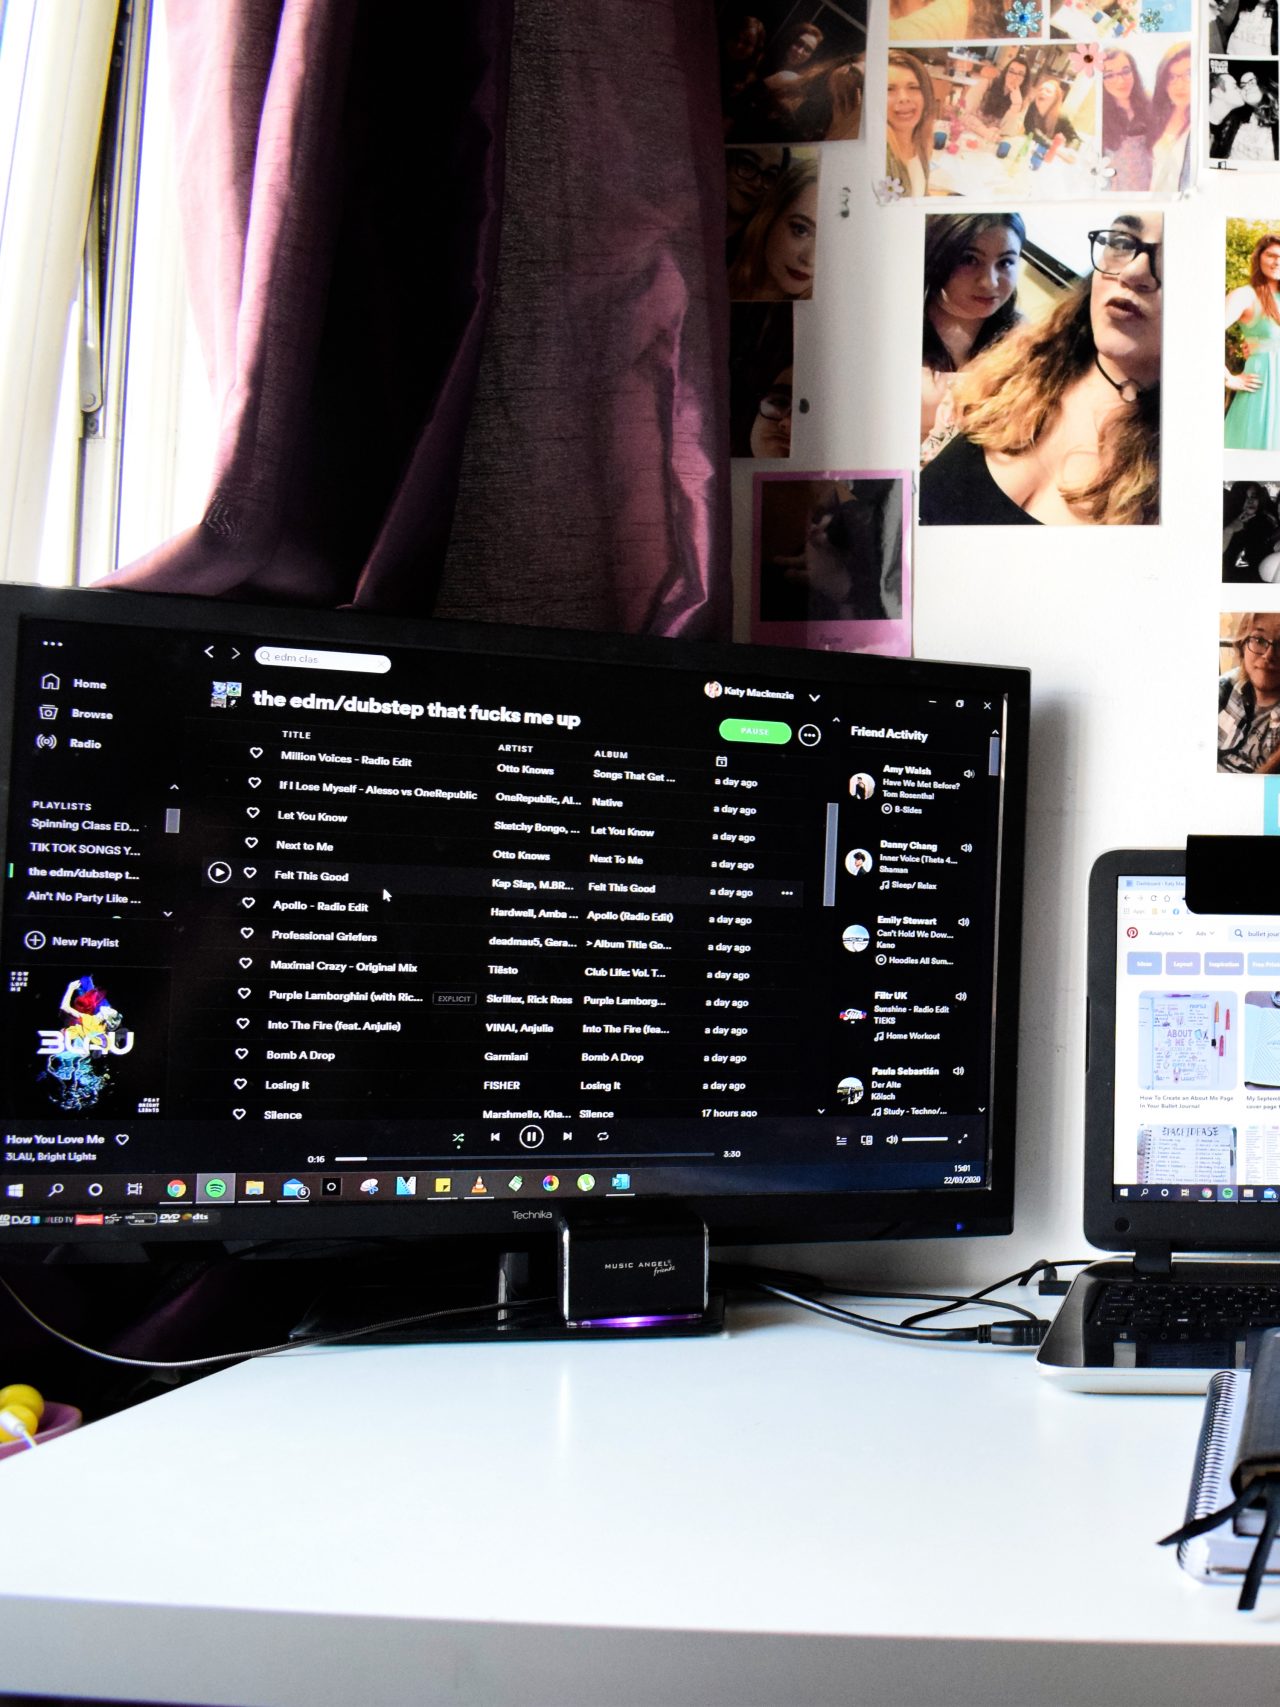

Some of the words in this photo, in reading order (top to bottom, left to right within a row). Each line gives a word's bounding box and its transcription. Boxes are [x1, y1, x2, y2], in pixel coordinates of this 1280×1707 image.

[274, 653, 297, 662] edm
[73, 678, 107, 689] Home
[724, 686, 746, 698] Katy
[746, 687, 794, 700] Mackenzie
[71, 708, 113, 720] Browse
[252, 689, 286, 707] the
[288, 692, 424, 719] edm/dubstep
[426, 701, 466, 719] that
[469, 704, 521, 723] fucks
[523, 711, 554, 725] me
[556, 714, 581, 730] up
[281, 730, 311, 739] TITLE
[740, 727, 769, 736] PAUSE
[850, 725, 885, 738] Friend
[885, 728, 928, 743] Activity
[69, 738, 102, 749] Radio
[497, 743, 533, 753] ARTIST
[593, 750, 628, 759] ALBUM
[496, 763, 520, 773] Otto
[521, 764, 554, 775] Knows
[882, 764, 904, 775] Amy
[904, 765, 931, 775] Walsh
[722, 776, 739, 788] day
[740, 779, 758, 789] ago
[882, 789, 898, 798] Tom
[898, 790, 934, 800] Rosenthal
[32, 800, 92, 811] PLAYLISTS
[591, 797, 623, 807] Native
[894, 805, 922, 814] B-Sides
[277, 810, 295, 820] Let
[295, 811, 316, 821] You
[317, 812, 348, 822] Know
[30, 817, 79, 831] Spinning
[81, 820, 111, 830] Class
[113, 821, 139, 832] ED...
[29, 842, 50, 852] TIK
[50, 842, 77, 853] TOK
[78, 844, 121, 855] SONGS
[122, 846, 140, 856] Y...
[879, 839, 908, 851] Danny
[908, 841, 937, 852] Chang
[274, 870, 294, 879] Felt
[296, 870, 318, 880] This
[319, 871, 349, 882] Good
[876, 915, 902, 926] Emily
[902, 916, 937, 925] Stewart
[271, 929, 334, 940] Professional
[335, 931, 377, 942] Griefers
[52, 936, 78, 946] New
[80, 937, 119, 949] Playlist
[268, 990, 303, 1001] Purple
[304, 990, 368, 1002] Lamborghini
[369, 991, 396, 1002] (with
[397, 992, 423, 1002] Ric...
[438, 995, 471, 1004] EXPLICIT
[486, 994, 525, 1005] Skrillex,
[526, 994, 548, 1004] Rick
[549, 995, 573, 1004] Ross
[874, 990, 894, 999] Filtr
[893, 991, 908, 1000] UK
[873, 1016, 896, 1024] TIEKS
[267, 1020, 289, 1029] Into
[289, 1020, 310, 1030] The
[312, 1020, 333, 1030] Fire
[334, 1020, 361, 1031] (feat.
[361, 1021, 401, 1032] Anjulie)
[885, 1031, 908, 1039] Home
[908, 1032, 940, 1040] Workout
[1167, 1029, 1192, 1038] ABOUT
[483, 1052, 528, 1061] Garmiani
[581, 1052, 610, 1061] Bomb
[610, 1052, 619, 1061] A
[619, 1052, 644, 1063] Drop
[265, 1080, 300, 1092] Losing
[301, 1080, 310, 1090] It
[483, 1080, 520, 1090] FISHER
[263, 1110, 302, 1120] Silence
[701, 1108, 712, 1117] 17
[713, 1108, 739, 1117] hours
[740, 1110, 757, 1118] ago
[5, 1134, 33, 1144] How
[33, 1134, 55, 1144] You
[56, 1134, 84, 1144] Love
[85, 1134, 105, 1144] Me
[5, 1152, 35, 1162] 3LAU,
[37, 1151, 66, 1162] Bright
[67, 1151, 97, 1162] Lights
[307, 1155, 325, 1163] 0:16
[723, 1150, 741, 1158] 3:30
[954, 1164, 970, 1172] 15:01
[943, 1175, 981, 1184] 22/03/2020
[512, 1210, 553, 1220] Technika
[604, 1262, 634, 1270] MUSIC
